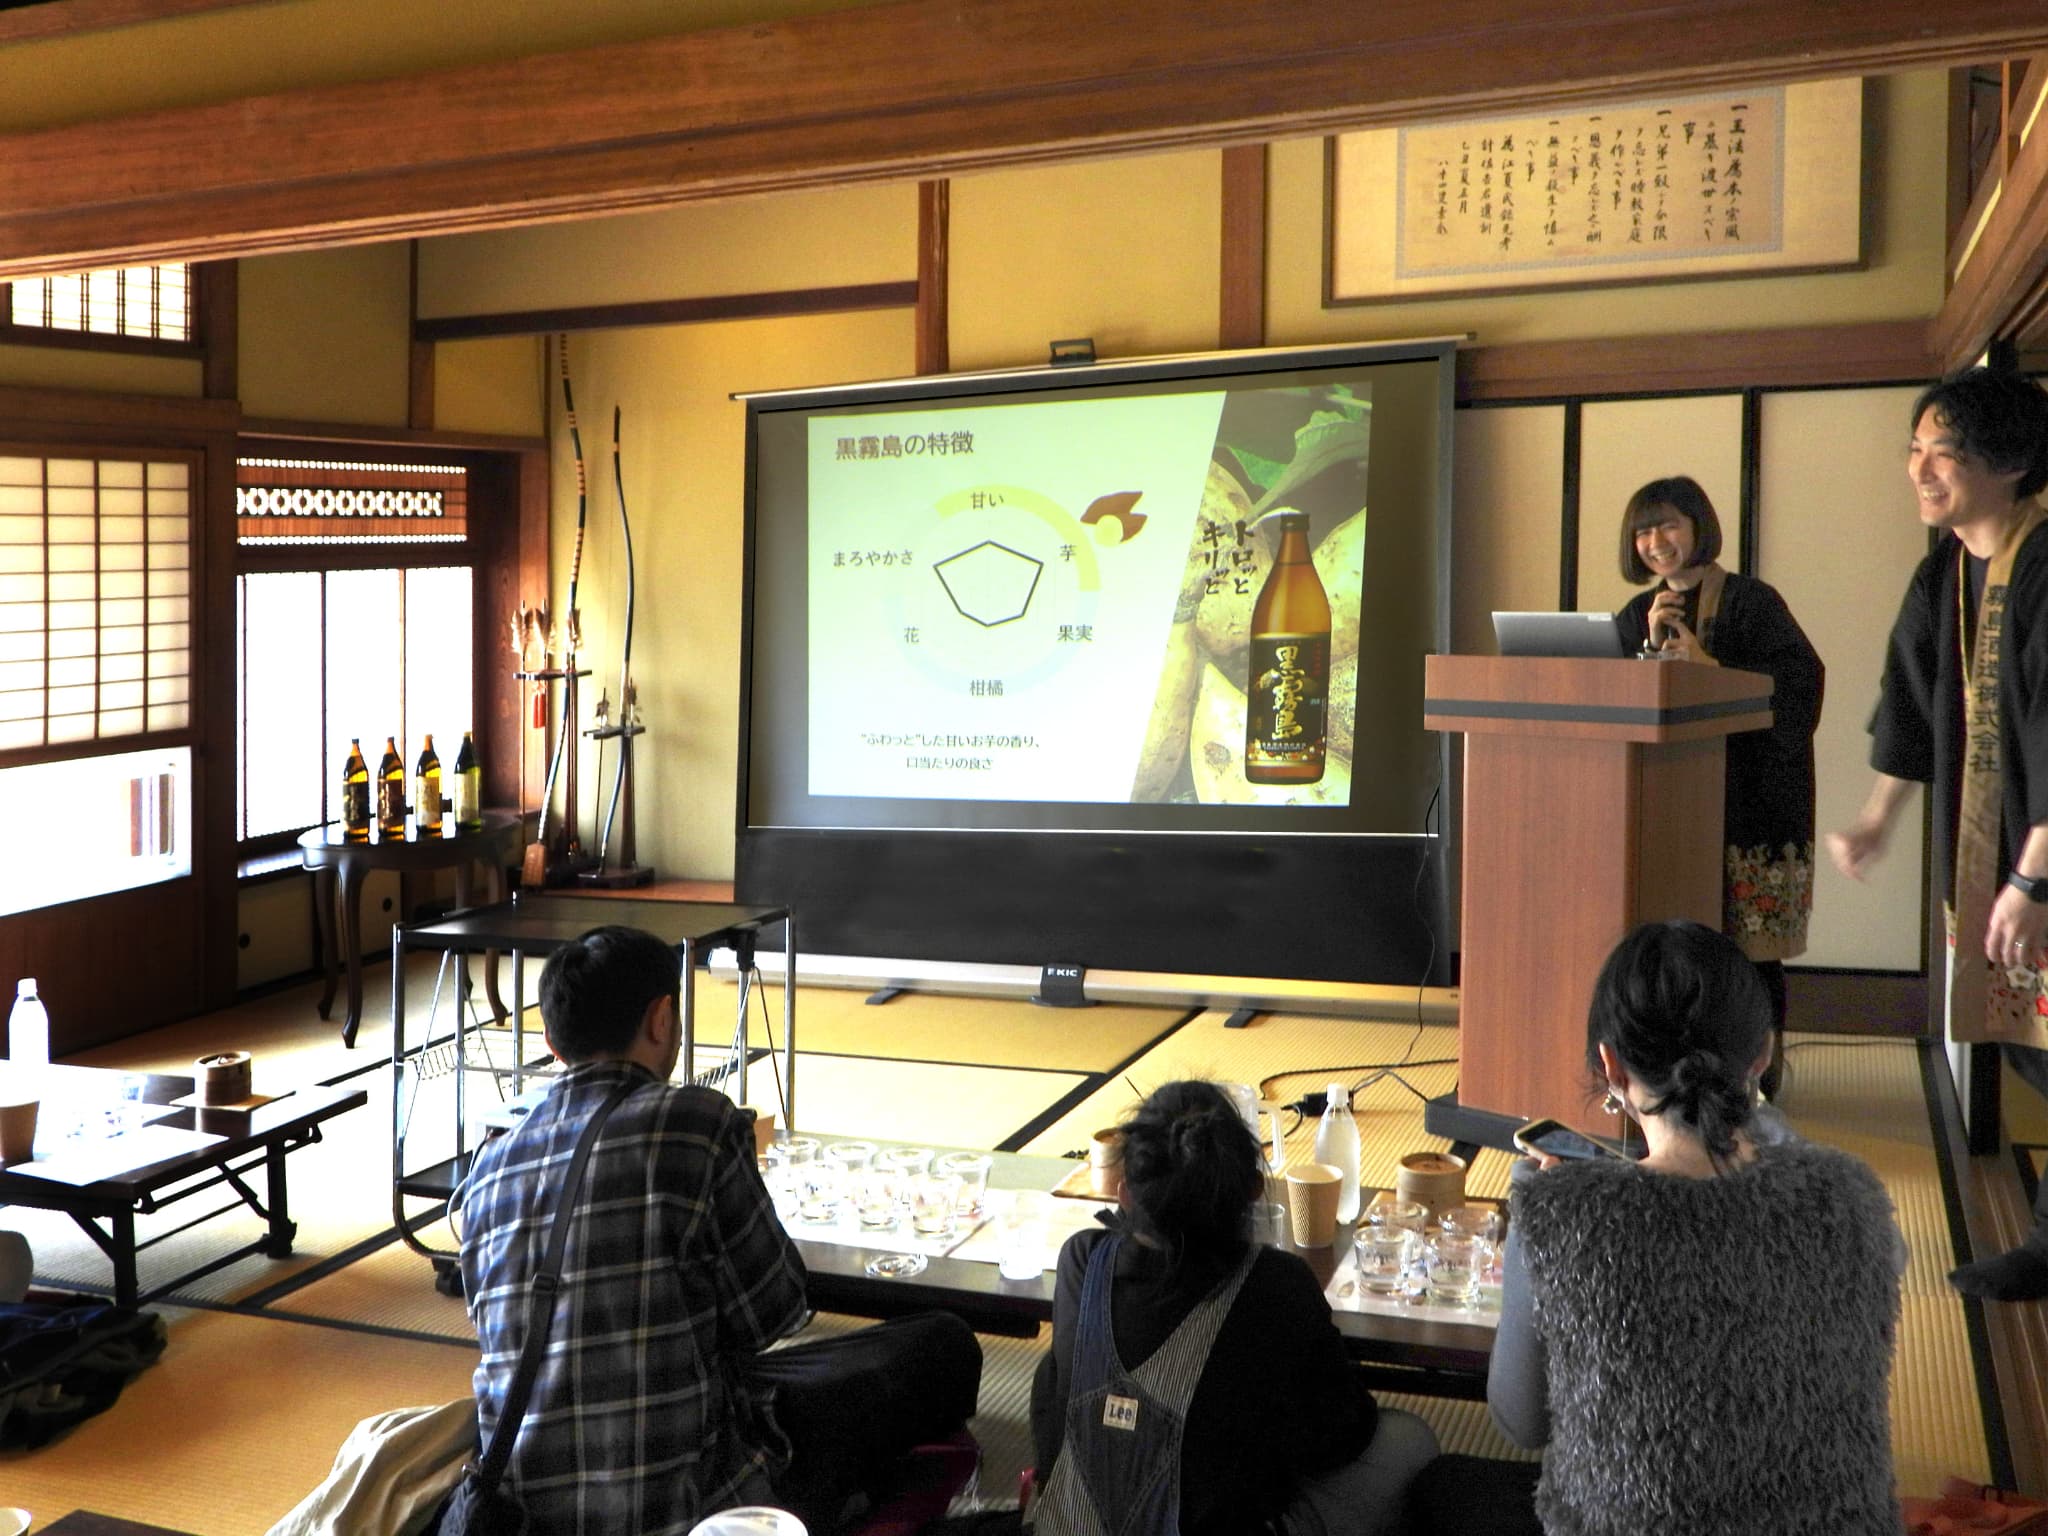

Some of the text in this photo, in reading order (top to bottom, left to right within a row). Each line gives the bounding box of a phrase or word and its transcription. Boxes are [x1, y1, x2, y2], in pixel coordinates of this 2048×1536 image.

[836, 430, 974, 460] 黒霧島の特徴
[970, 491, 1005, 509] 甘い
[832, 549, 914, 567] まろやかさ
[1059, 544, 1077, 562] 芋
[1202, 520, 1230, 595] キリッと
[904, 626, 921, 644] 花
[1056, 625, 1094, 643] 果実
[969, 679, 1004, 697] 柑橘
[1271, 645, 1306, 741] 黒霧島
[906, 756, 994, 771] 口当たりの良さ
[1109, 1403, 1132, 1421] Lee
